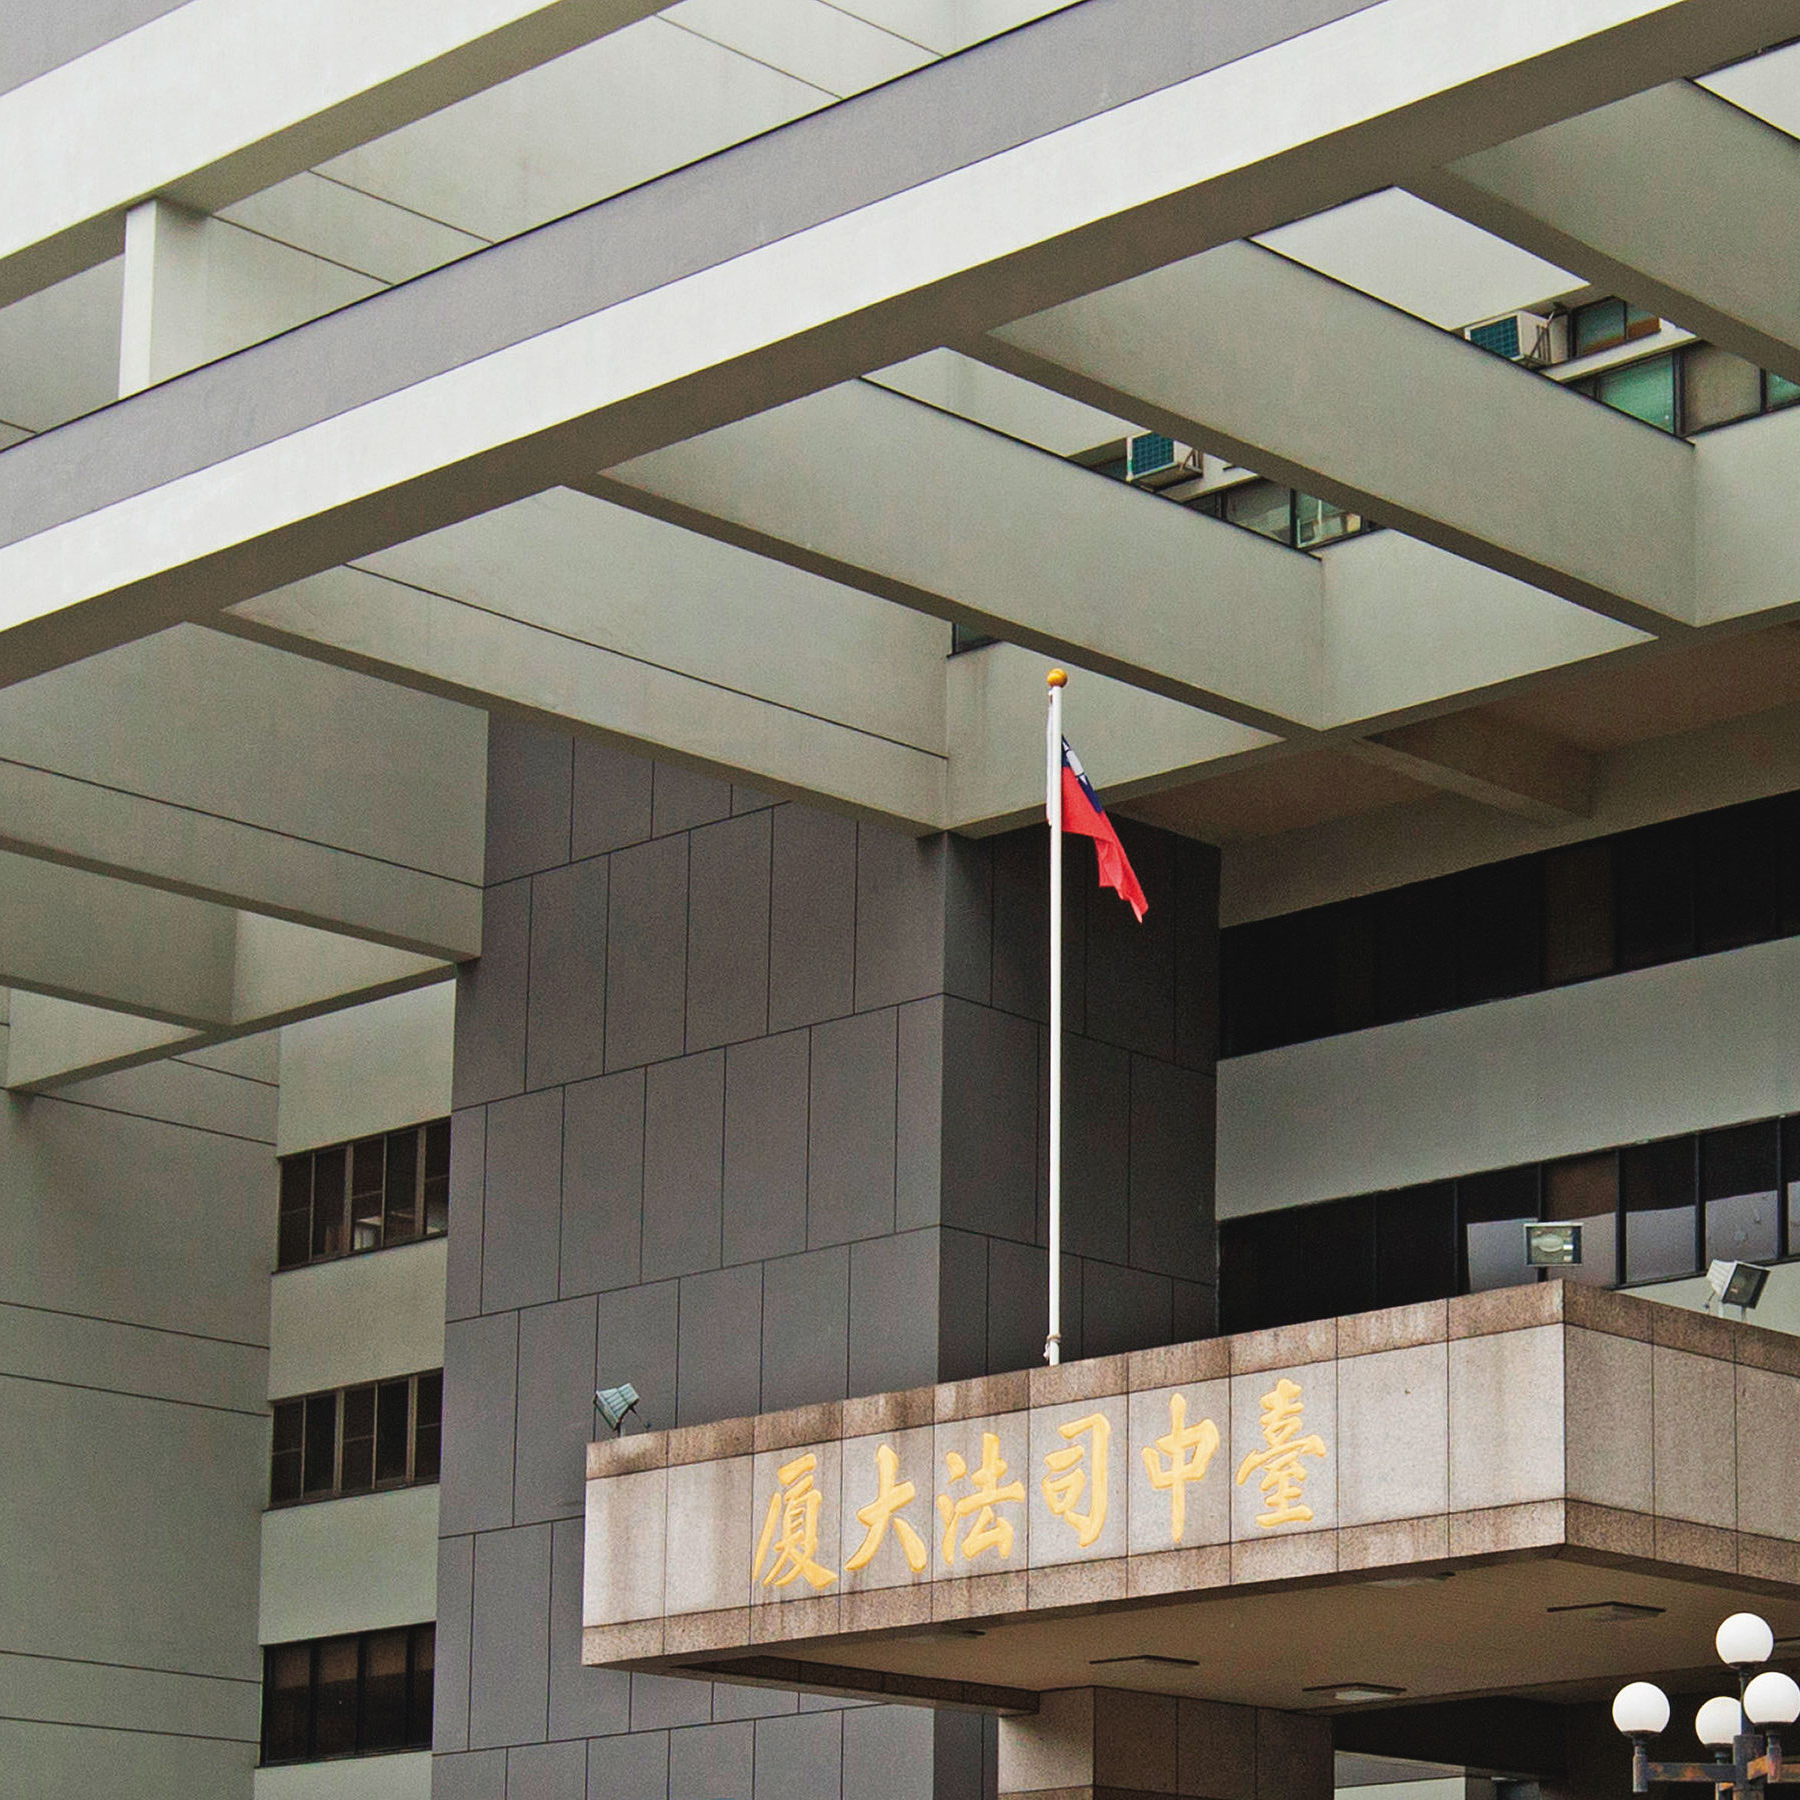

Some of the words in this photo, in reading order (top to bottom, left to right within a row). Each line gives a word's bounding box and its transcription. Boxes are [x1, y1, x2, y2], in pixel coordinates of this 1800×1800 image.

[752, 1378, 1326, 1591] 臺中司法大廈
